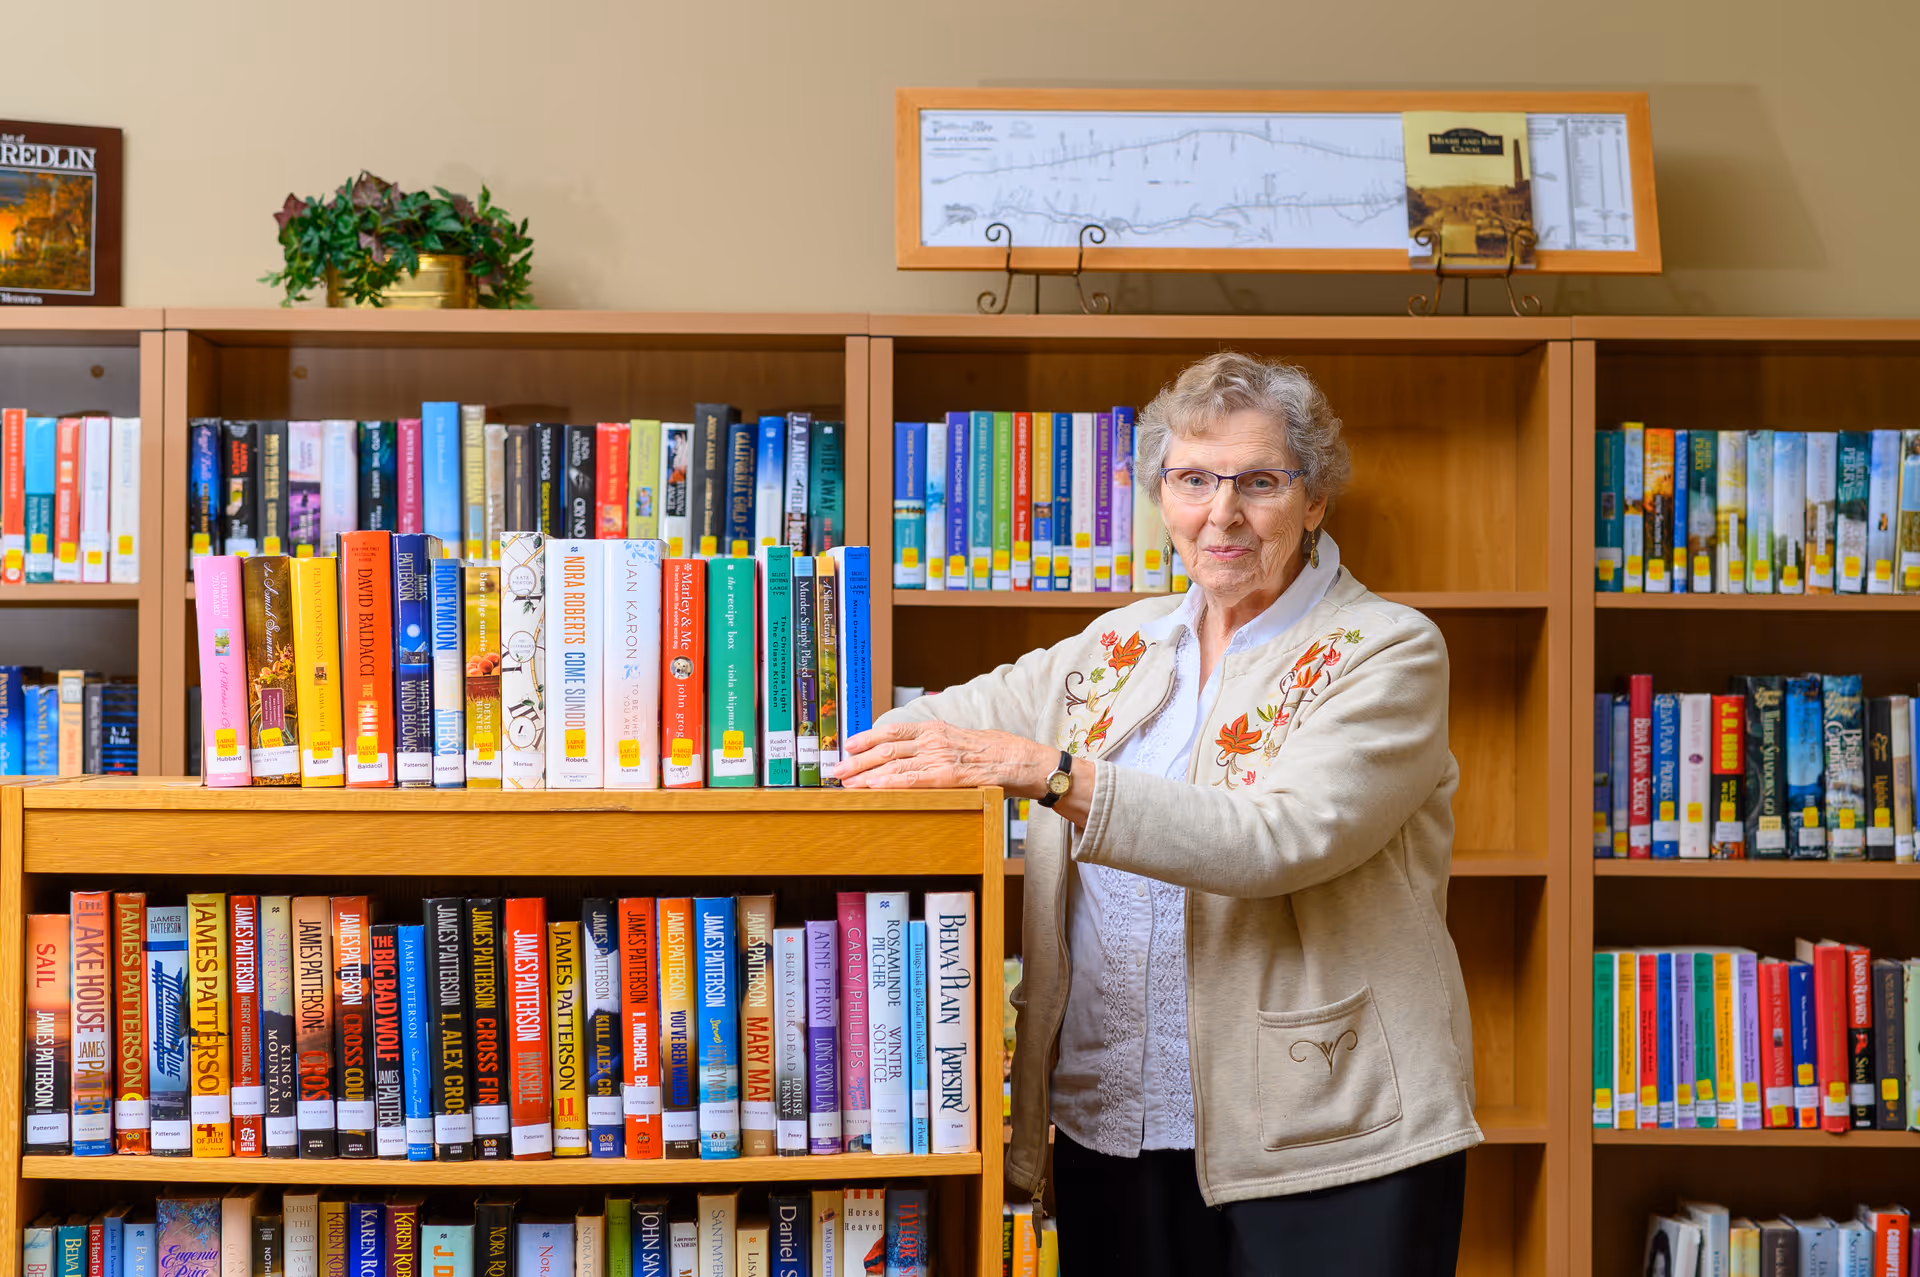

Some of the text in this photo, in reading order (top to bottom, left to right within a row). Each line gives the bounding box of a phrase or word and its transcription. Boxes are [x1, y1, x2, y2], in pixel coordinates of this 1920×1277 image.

[0, 143, 96, 169] REDLIN
[357, 567, 374, 608] DAVID
[399, 552, 414, 601] PATTERSON
[413, 573, 428, 601] JAMES
[564, 556, 585, 645] NORA ROBERTS
[435, 565, 457, 651] HONEYMOON
[626, 559, 638, 659] JAN KARON
[678, 572, 692, 650] Marley & Me
[725, 593, 737, 649] recipe box
[796, 581, 813, 678] Murder Simply Played
[821, 589, 833, 645] Silent Betrayal
[358, 613, 375, 677] BALDACCI
[564, 652, 586, 685] COME
[362, 684, 373, 698] THE
[632, 684, 639, 711] TO BE
[676, 684, 686, 708] john
[727, 664, 736, 688] viola
[779, 688, 788, 713] Light
[400, 680, 417, 753] WIND BLOWS
[150, 915, 182, 923] JAMES
[150, 923, 182, 934] PATTERSON
[190, 901, 218, 984] JAMES
[372, 936, 393, 948] THE
[592, 911, 608, 944] JAMES
[36, 943, 57, 988] SAIL
[234, 904, 254, 993] JAMES PATTERSON
[298, 919, 325, 1030] JAMES PATTERSON
[340, 912, 362, 1005] JAMES PATTERSON
[436, 904, 460, 1006] JAMES PATTERSON
[472, 907, 495, 1009] JAMES PATTERSON
[627, 911, 648, 1004] JAMES PATTERSON
[667, 910, 686, 1001] JAMES PATTERSON
[703, 912, 726, 1008] JAMES PATTERSON
[746, 911, 766, 1008] JAMES PATTERSON
[872, 937, 886, 990] PILCHER
[886, 919, 901, 1007] ROSAMUNDE
[936, 912, 972, 1025] BELVA PLAIN
[118, 903, 142, 1088] JAMES PATTERSON
[513, 929, 541, 1041] JAMES PATTERSON
[814, 930, 832, 1023] ANNE PERRY
[847, 927, 864, 1069] CARLY PHILLIPS
[77, 975, 104, 1034] HOUSE
[372, 949, 399, 1062] BIG BAD WOLF
[406, 976, 418, 1039] PATTERSON
[553, 930, 576, 1091] JAMES PATTERSON
[34, 1010, 54, 1107] JAMES PATTERSON
[77, 1040, 105, 1058] JAMES
[343, 1013, 363, 1067] CROSS
[442, 1030, 463, 1070] ALEX
[475, 1018, 498, 1072] CROSS
[632, 1023, 647, 1071] MICHAEL
[746, 1016, 770, 1065] MARY
[873, 1023, 887, 1084] SOLSTICE
[888, 1026, 902, 1080] WINTER
[267, 1029, 279, 1114] MOUNTAIN
[290, 1235, 315, 1244] LORD
[293, 1220, 312, 1228] THE
[327, 1211, 345, 1249] KAREN
[360, 1209, 378, 1257] KAREN
[394, 1211, 415, 1250] KAREN
[639, 1210, 662, 1250] JOHN
[779, 1205, 798, 1262] Daniel
[844, 1222, 884, 1232] Heaven
[848, 1208, 880, 1217] Horse
[898, 1201, 918, 1259] TAYLOR
[64, 1238, 82, 1272] BELVA
[91, 1229, 101, 1270] It's Hard to
[161, 1245, 217, 1267] Eugenia
[489, 1227, 507, 1256] NORA
[582, 1227, 592, 1260] NORA
[824, 1228, 833, 1254] MAJOR
